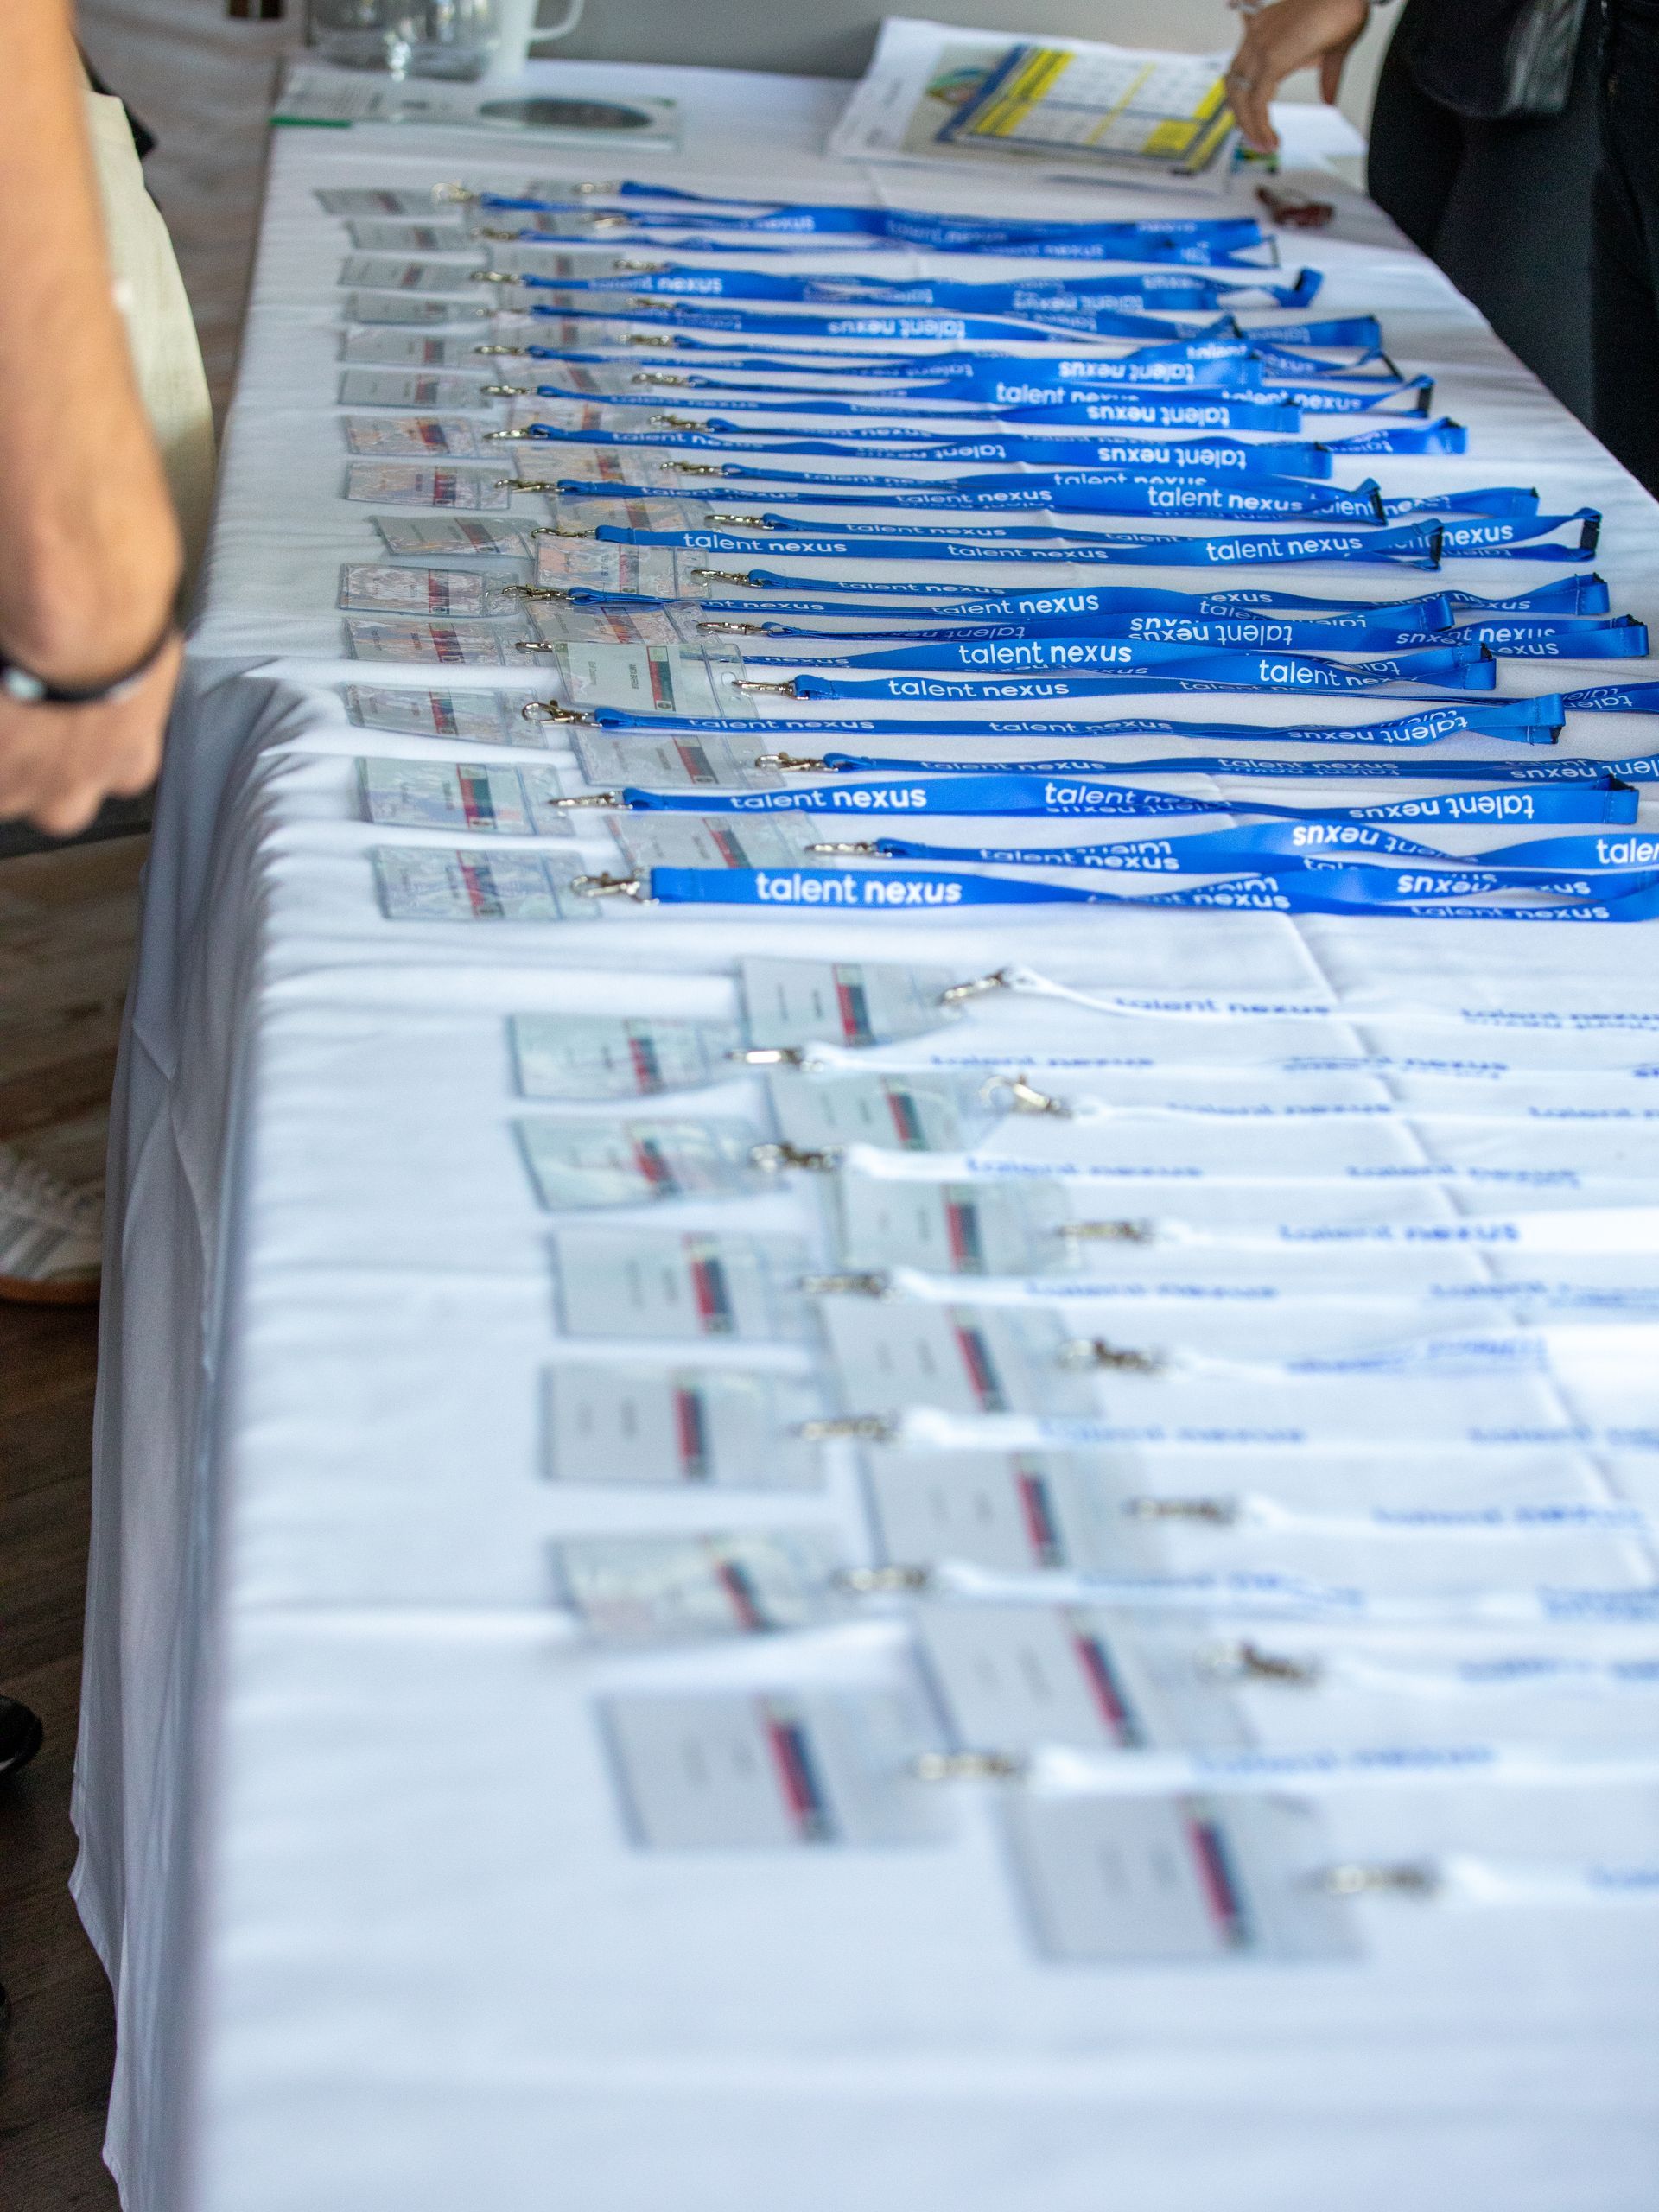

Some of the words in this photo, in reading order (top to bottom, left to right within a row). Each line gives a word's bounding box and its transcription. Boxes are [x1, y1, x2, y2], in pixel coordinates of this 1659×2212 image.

[656, 277, 723, 295] nexus
[827, 320, 896, 336] nexus
[899, 319, 966, 339] talent
[1058, 361, 1126, 379] nexus
[1128, 362, 1195, 385] talent
[996, 381, 1065, 404] talent
[1294, 394, 1363, 410] nexus
[1087, 405, 1157, 423] nexus
[1162, 406, 1230, 428] talent
[612, 432, 685, 443] talent
[935, 444, 1006, 460] talent
[1097, 448, 1170, 463] nexus
[1175, 448, 1247, 471] talent
[804, 473, 876, 483] talent
[640, 487, 717, 498] talent
[895, 493, 973, 505] talent
[977, 489, 1052, 503] nexus
[1147, 486, 1223, 508] talent
[1228, 493, 1303, 511] nexus
[846, 524, 924, 534] talent
[930, 527, 1006, 536] nexus
[1105, 532, 1181, 543] talent
[1441, 524, 1514, 548] nexus
[683, 532, 764, 551] talent
[768, 542, 848, 553] nexus
[1206, 538, 1283, 562] talent
[1287, 537, 1363, 556] nexus
[947, 543, 1027, 558] talent
[1032, 550, 1109, 559] nexus
[838, 582, 919, 591] talent
[925, 584, 1005, 594] nexus
[743, 601, 824, 611] nexus
[931, 598, 1014, 614] talent
[1020, 594, 1099, 613] nexus
[1205, 593, 1274, 603] exus
[944, 626, 1026, 639] talent
[1128, 626, 1210, 641] nexus
[1215, 624, 1294, 646] talent
[1396, 631, 1469, 646] exus
[959, 641, 1044, 664] talent
[1050, 645, 1132, 663] nexus
[1490, 642, 1560, 655] exus
[765, 656, 849, 664] nexus
[1259, 659, 1340, 686] talent
[1344, 675, 1395, 687] nex
[888, 679, 976, 697] talent
[983, 683, 1070, 697] nexus
[1179, 681, 1261, 691] talent
[1563, 695, 1633, 709] talen
[689, 719, 779, 730] talent
[785, 720, 875, 729] nexus
[989, 722, 1079, 733] talent
[1084, 721, 1173, 732] nexus
[1381, 716, 1468, 744] talent
[1287, 730, 1374, 741] nexus
[920, 761, 1012, 771] talent
[1018, 760, 1106, 771] nexus
[1218, 758, 1304, 769] talent
[1601, 760, 1659, 776] lent
[1510, 766, 1597, 779] nexus
[730, 790, 826, 809] talent
[833, 788, 927, 808] nexus
[1045, 781, 1136, 804] talent
[1349, 799, 1440, 818] nexus
[1446, 793, 1535, 819] talent
[1293, 824, 1380, 846] nexus
[1596, 837, 1659, 864] tale
[979, 849, 1077, 865] talent
[1084, 855, 1179, 870] nexus
[755, 871, 858, 903] talent
[865, 878, 963, 904] nexus
[1398, 874, 1491, 893] nexus
[1193, 893, 1291, 909] nexus
[1411, 906, 1509, 918] talent
[1515, 906, 1610, 919] nexus
[1114, 995, 1220, 1014] talent
[1228, 1002, 1329, 1014] nexus
